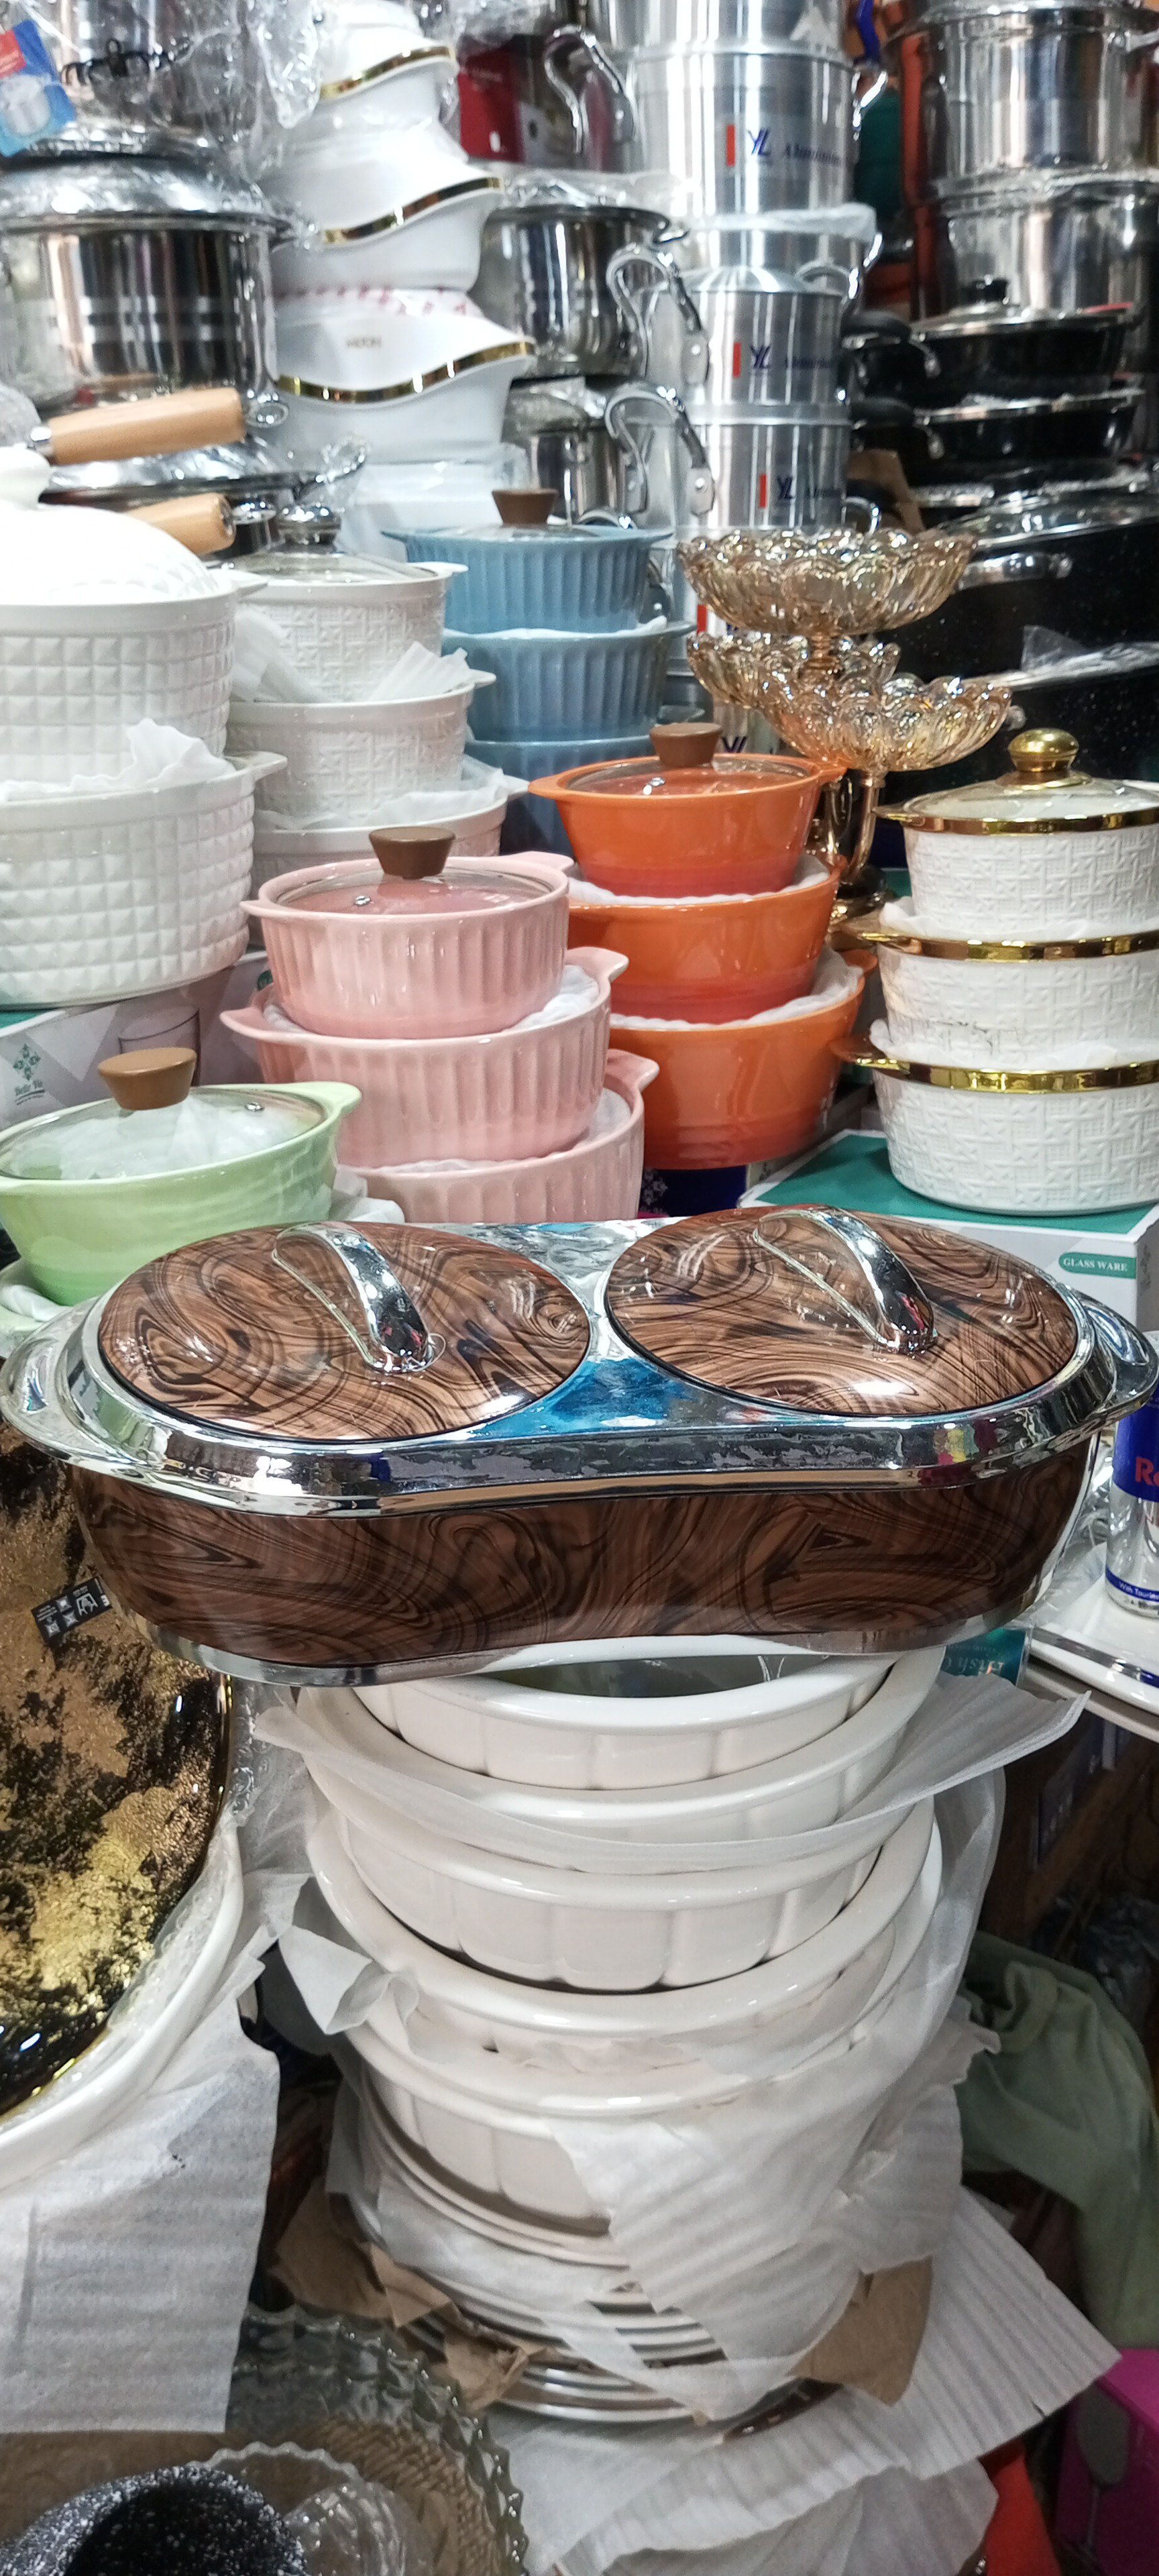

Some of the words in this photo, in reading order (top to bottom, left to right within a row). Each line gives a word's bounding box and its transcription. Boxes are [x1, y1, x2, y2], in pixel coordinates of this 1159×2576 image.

[1062, 1256, 1095, 1269] GLASS
[1097, 1260, 1127, 1272] WARE
[1119, 1581, 1134, 1594] With
